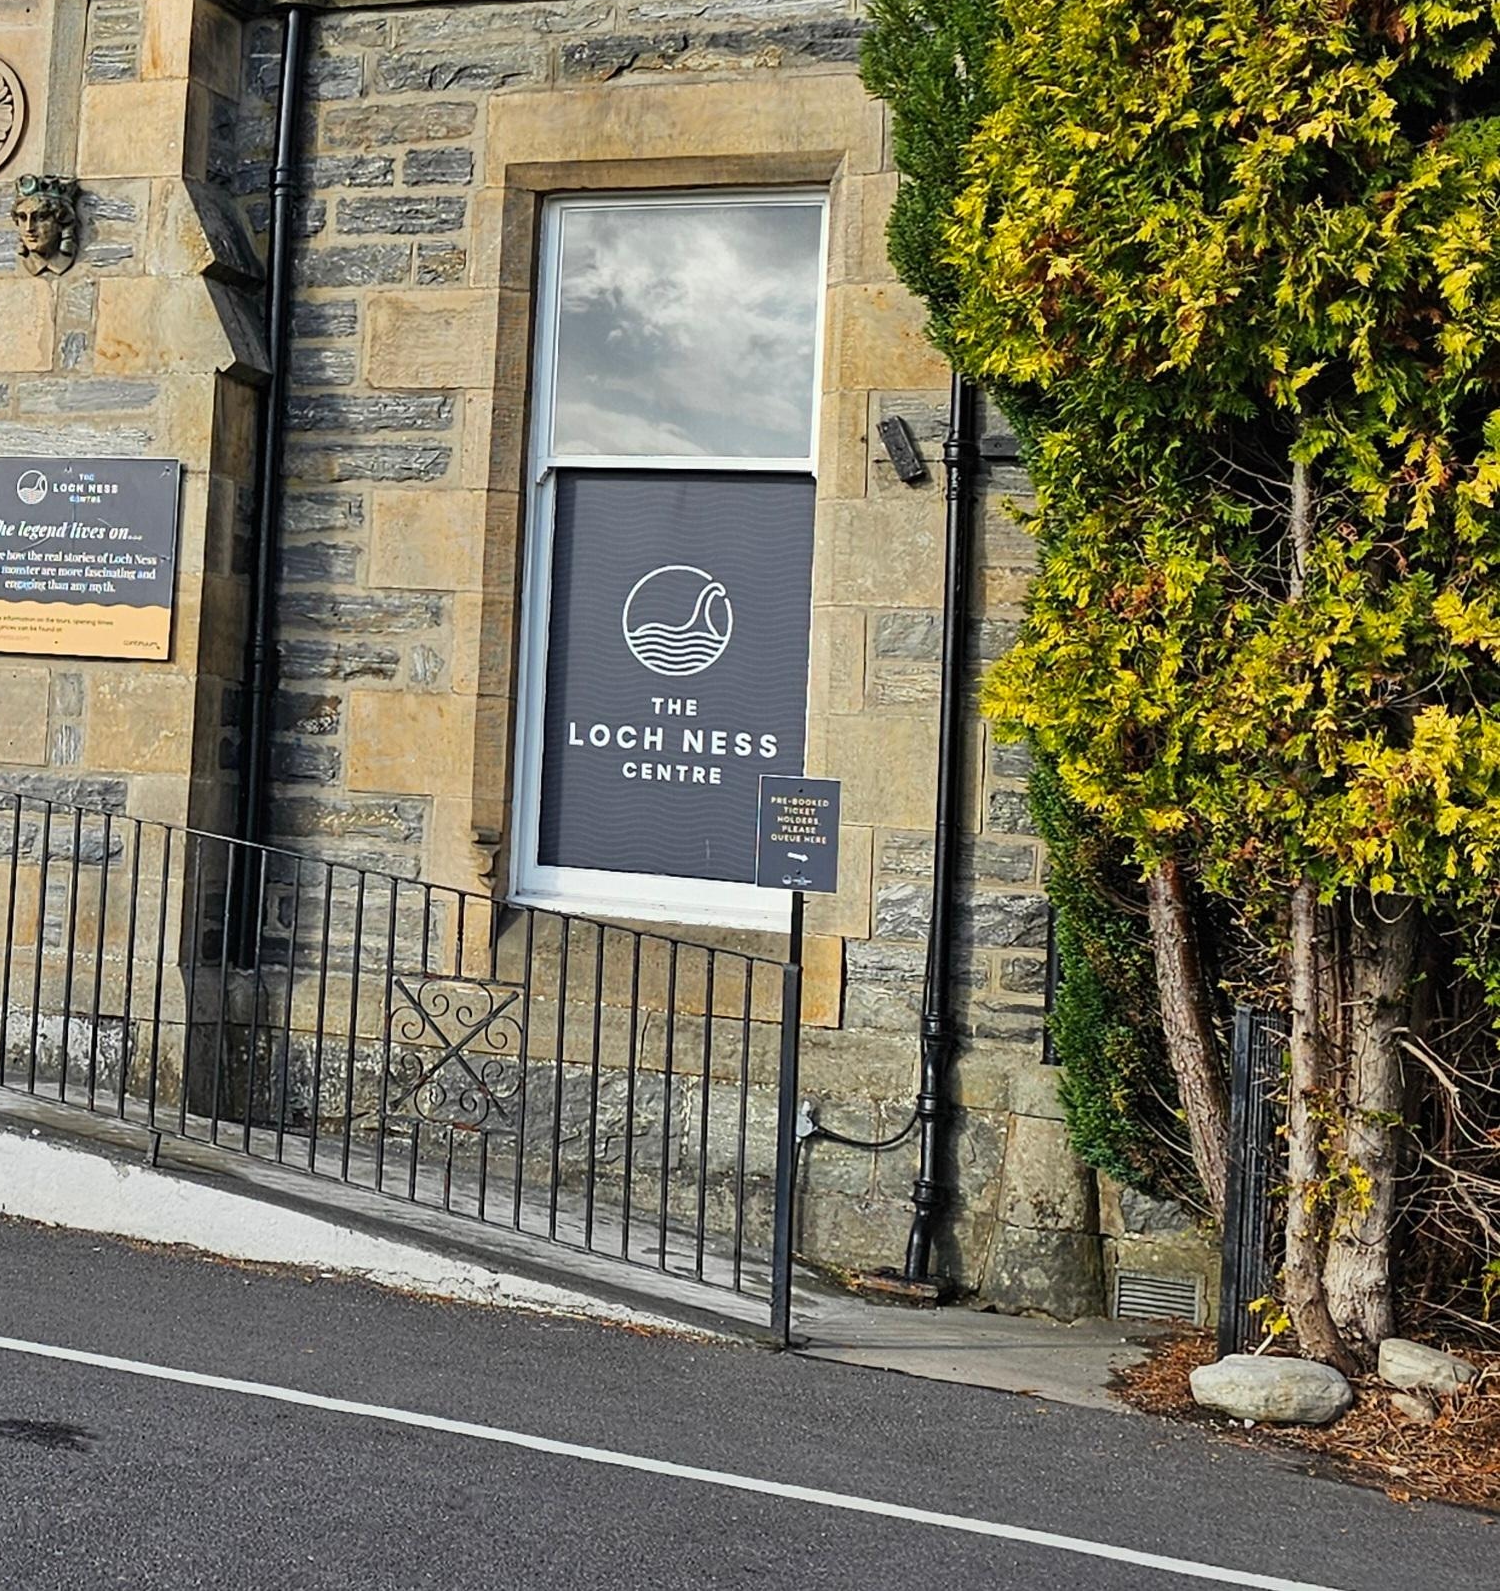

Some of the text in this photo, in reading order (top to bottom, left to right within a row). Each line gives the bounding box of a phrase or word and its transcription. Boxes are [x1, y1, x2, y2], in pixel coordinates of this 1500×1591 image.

[53, 483, 118, 493] LOCH NESS
[17, 521, 67, 540] legend
[69, 522, 106, 540] lives
[7, 550, 27, 561] how
[28, 550, 42, 561] the
[44, 552, 62, 562] real
[64, 552, 95, 563] stories
[97, 552, 107, 564] of
[109, 553, 132, 564] Loch
[134, 554, 157, 565] Ness
[1, 564, 40, 575] monster
[41, 567, 56, 576] are
[58, 567, 82, 577] more
[84, 567, 136, 581] fascinating
[137, 569, 156, 580] and
[5, 579, 116, 594] engaging than any myth.
[651, 697, 698, 716] THE
[568, 722, 779, 758] LOCH NESS
[622, 761, 722, 785] CENTRE
[771, 796, 829, 807] PRE-BOOKED
[783, 807, 816, 816] TICKET
[782, 825, 816, 834] PLEASE
[770, 833, 827, 845] QUEUE HERE
